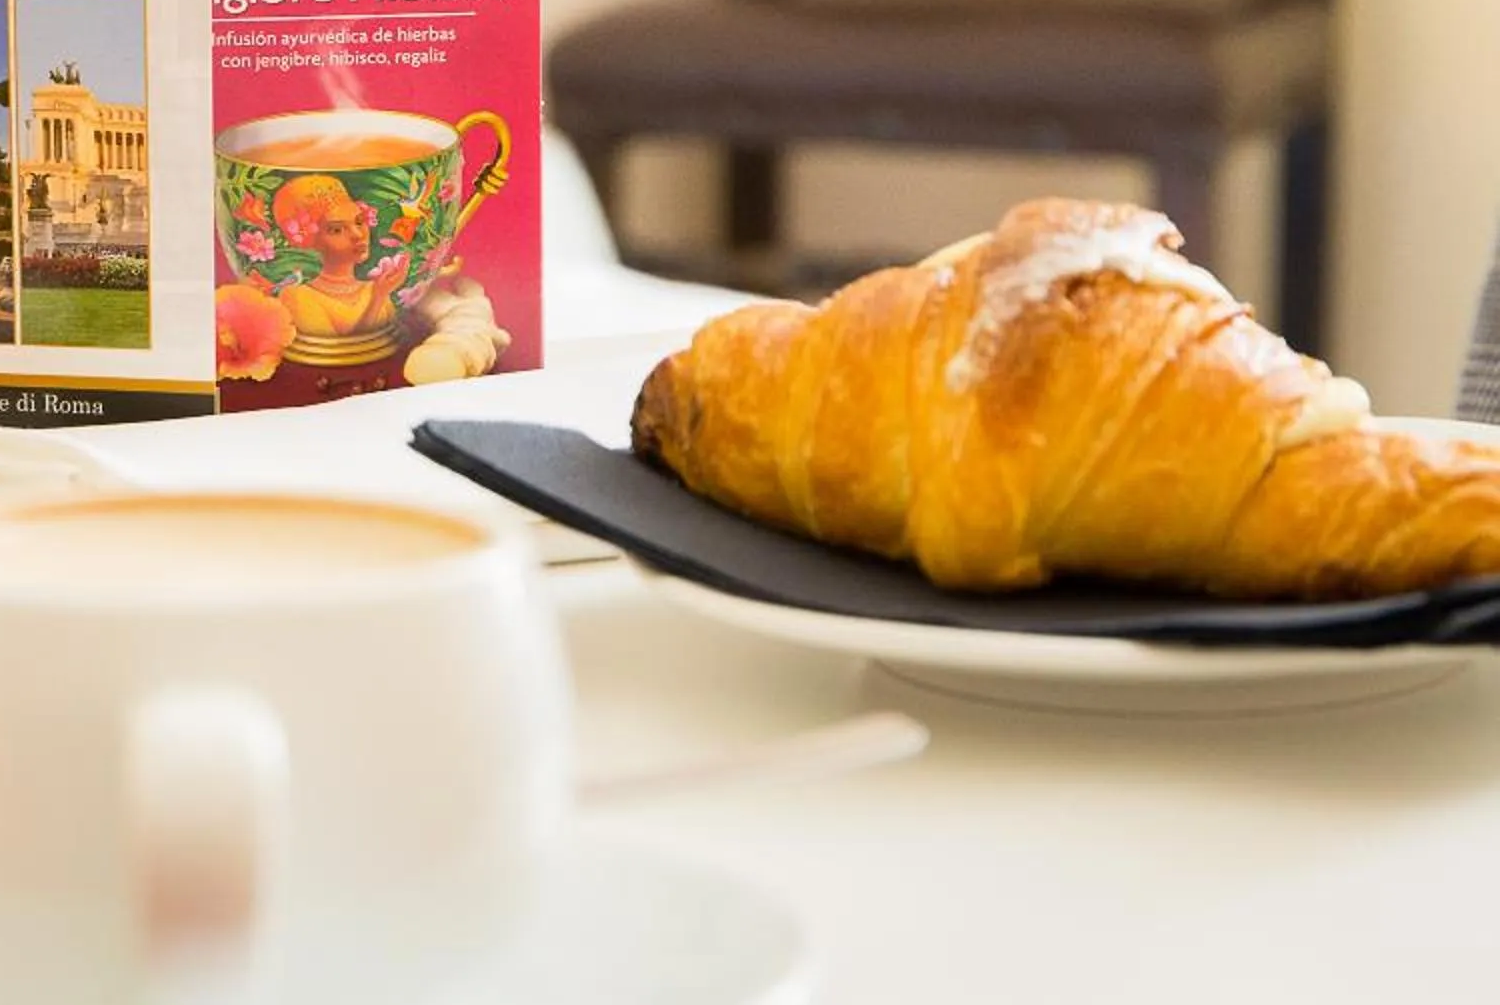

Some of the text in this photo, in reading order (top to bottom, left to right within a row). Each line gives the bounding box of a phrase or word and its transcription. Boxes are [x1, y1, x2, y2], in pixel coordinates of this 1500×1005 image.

[281, 28, 368, 49] ayurvédica
[372, 26, 393, 43] de
[397, 25, 457, 42] hierbas
[221, 46, 448, 72] con jengibre, hibisco, regaliz
[16, 392, 36, 412] di
[44, 394, 105, 415] Roma
